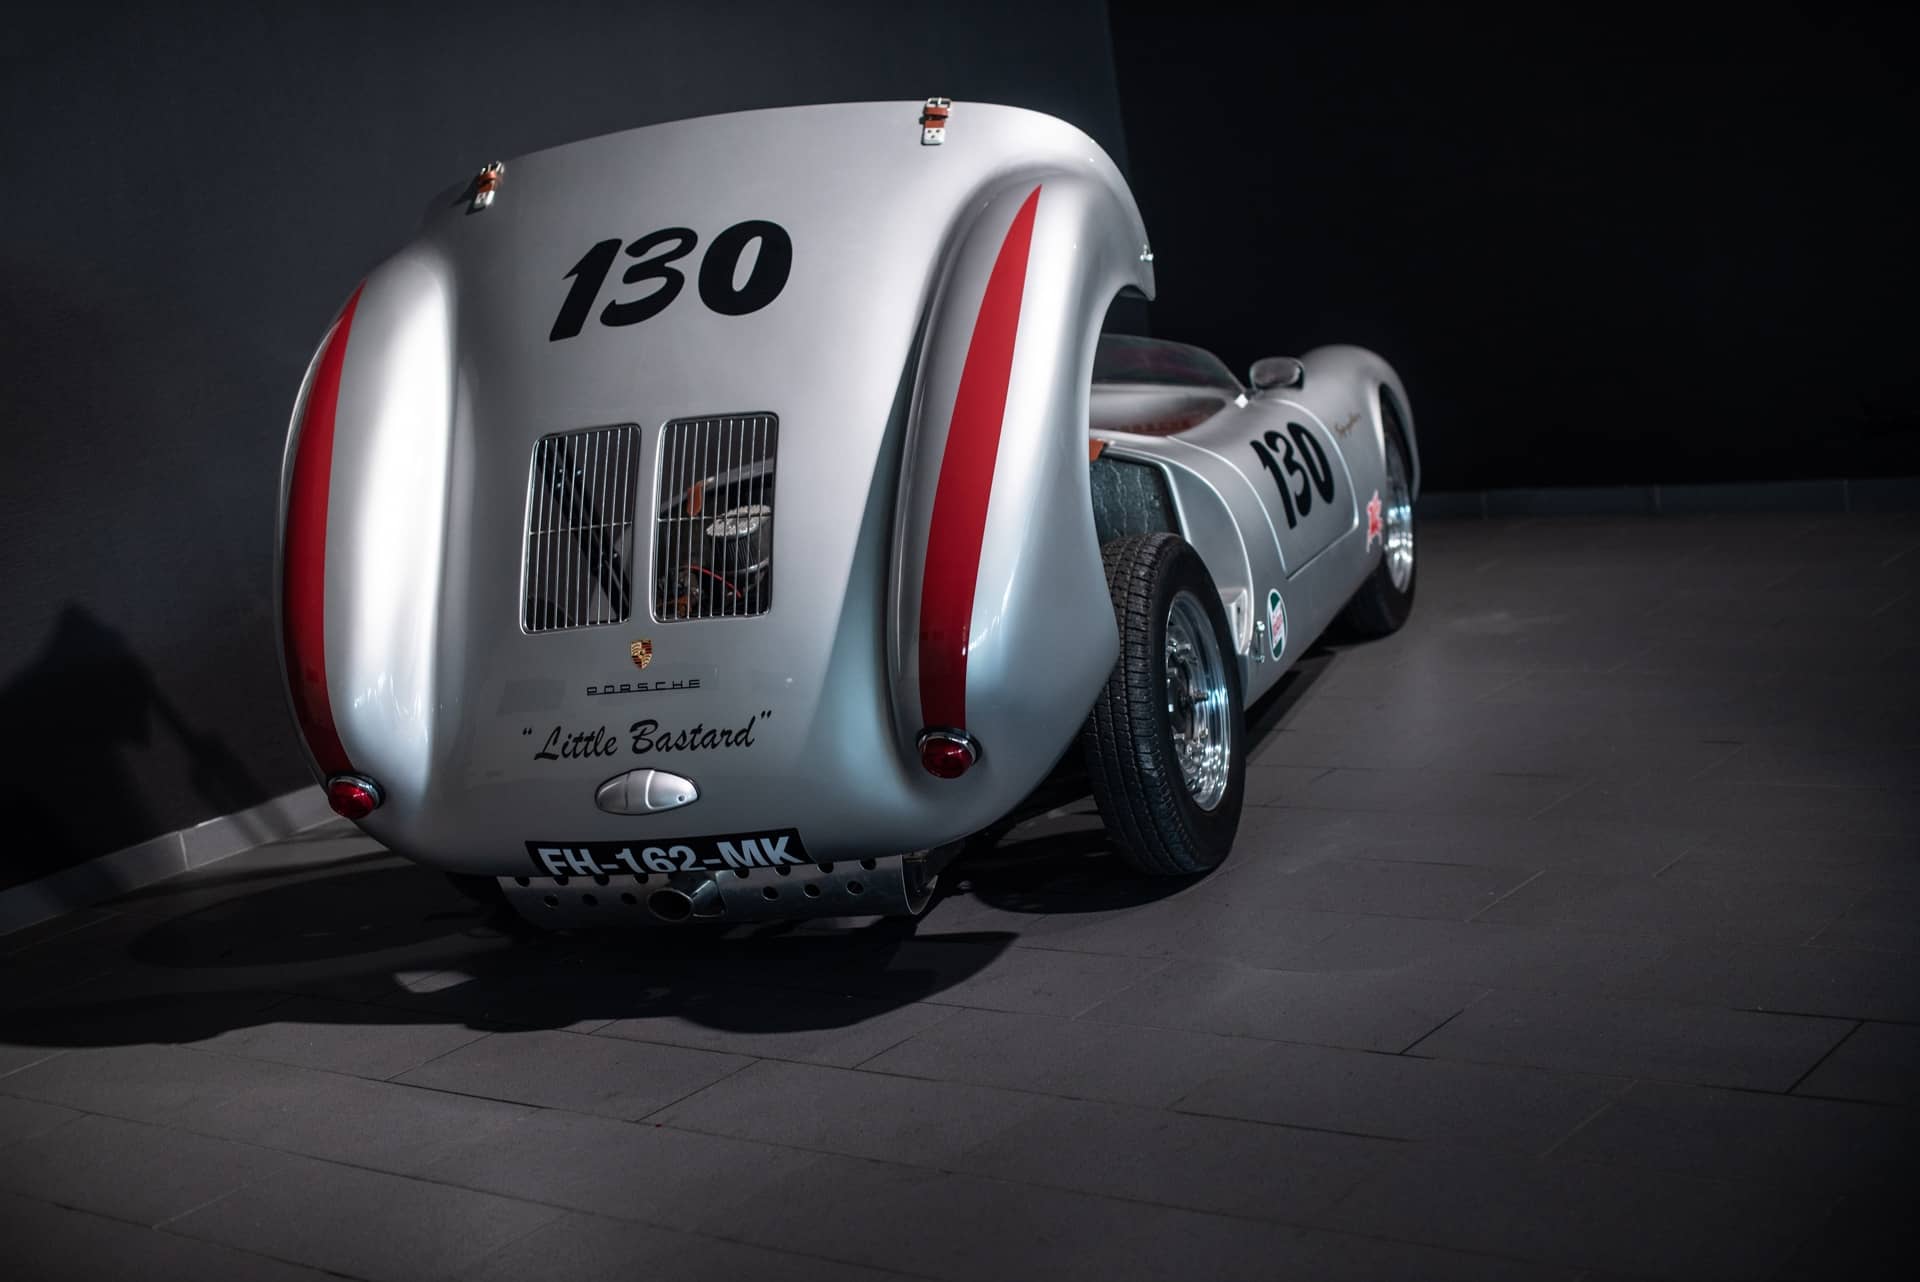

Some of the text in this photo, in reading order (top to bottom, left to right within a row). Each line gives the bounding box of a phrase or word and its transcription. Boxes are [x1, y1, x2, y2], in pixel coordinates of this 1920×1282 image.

[550, 220, 793, 342] 130
[1250, 423, 1335, 529] 130
[586, 679, 701, 697] PORSCHE
[537, 835, 808, 876] FH-162-MK
